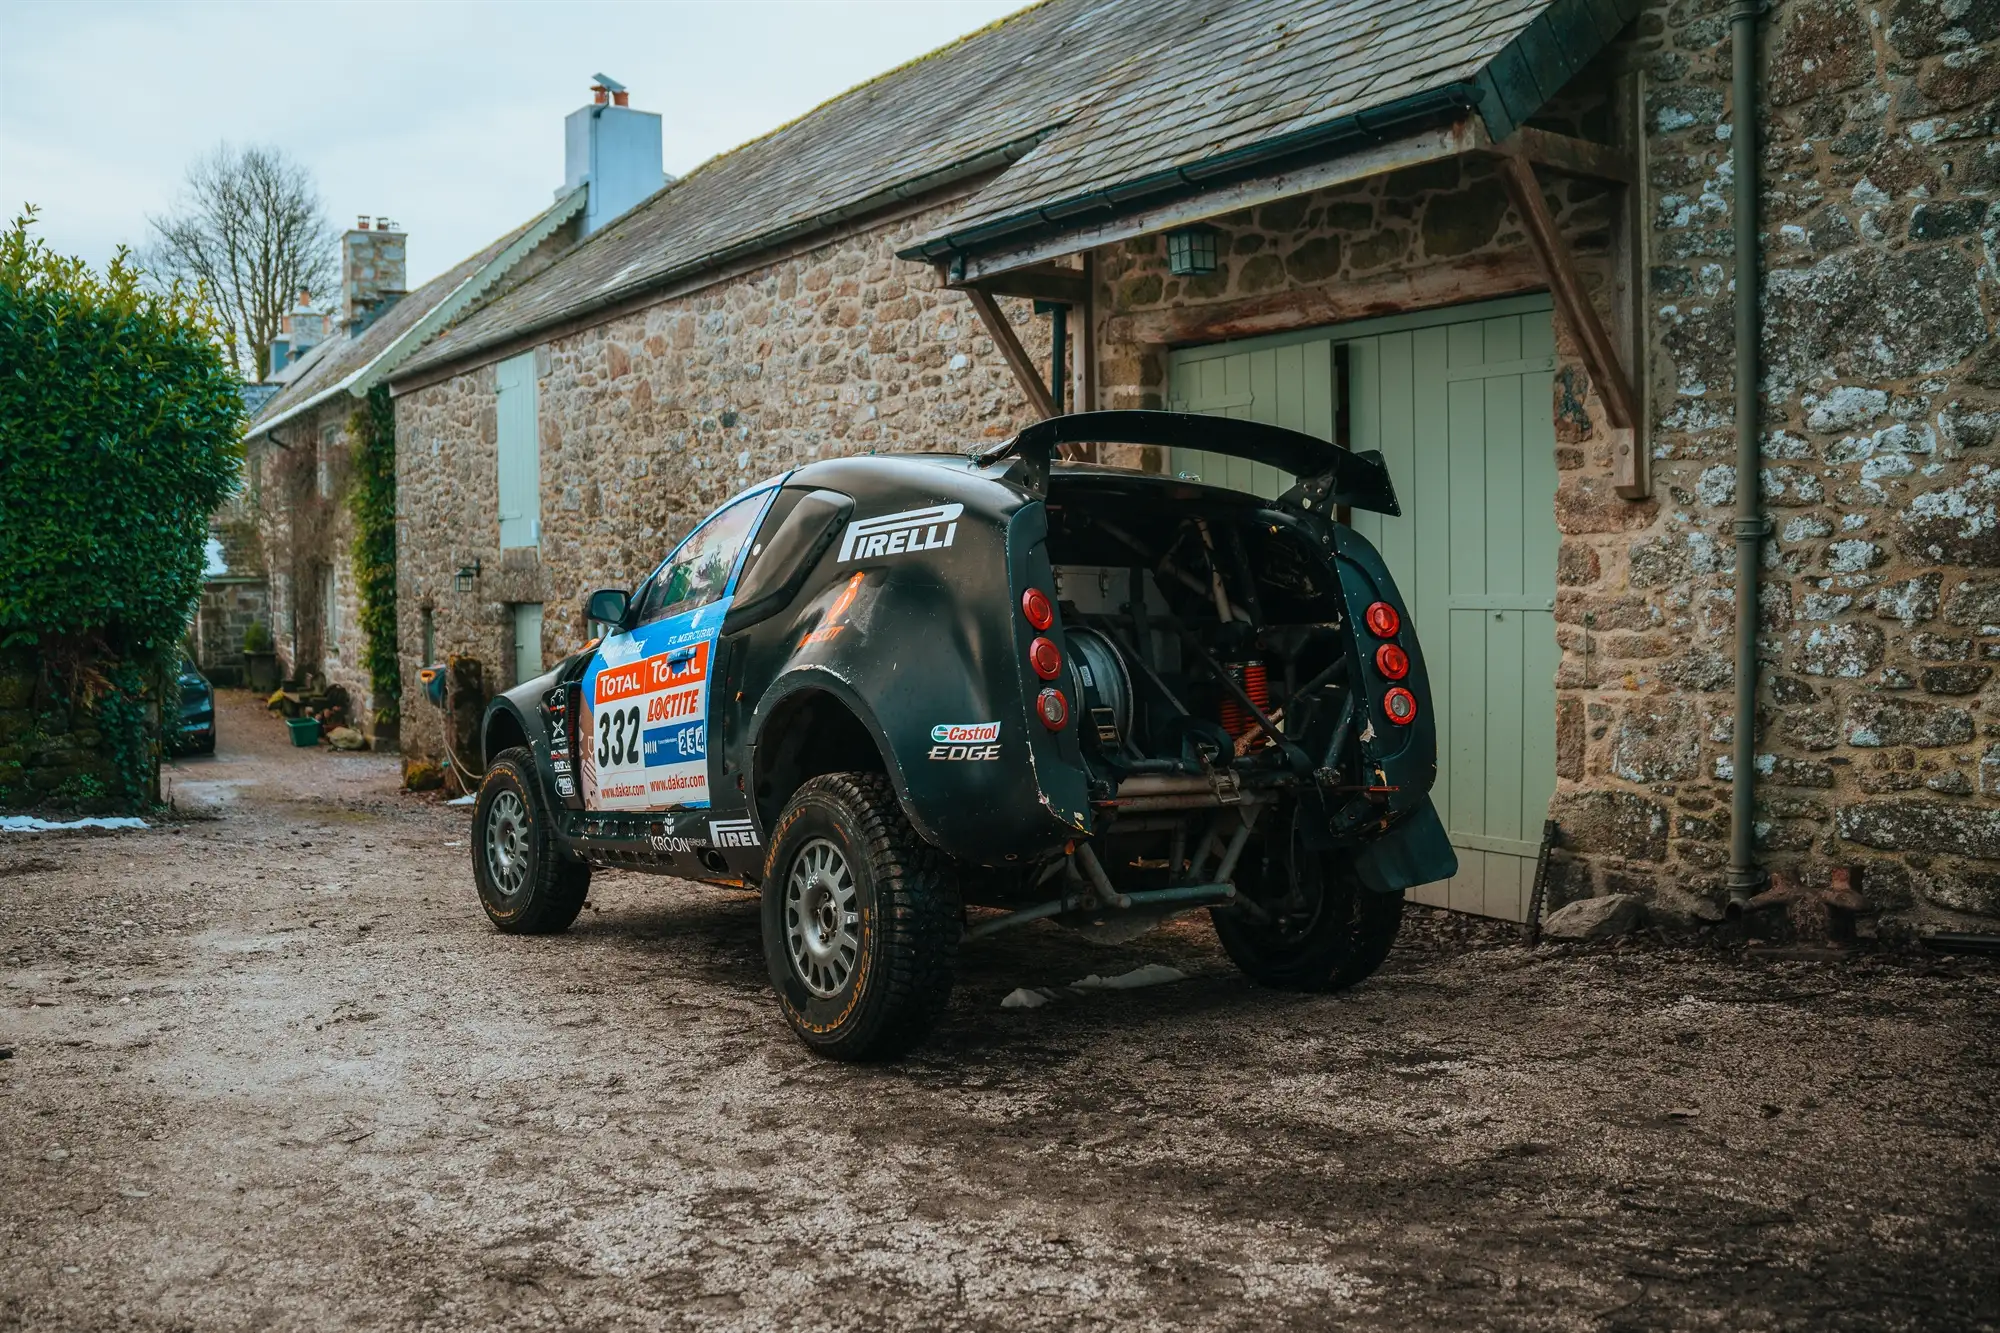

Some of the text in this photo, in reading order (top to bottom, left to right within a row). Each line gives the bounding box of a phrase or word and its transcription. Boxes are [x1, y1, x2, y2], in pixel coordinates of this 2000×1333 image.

[836, 503, 964, 563] PIRELLI
[600, 672, 641, 697] TOTAL
[646, 688, 699, 722] LOCTITE
[597, 705, 640, 768] 332
[947, 723, 997, 742] Castrol
[928, 744, 1002, 761] EDGE
[601, 783, 645, 799] www.dakar.com
[650, 774, 705, 792] www.dakar.com
[650, 835, 691, 853] KROON
[826, 907, 870, 1033] SCORPION
